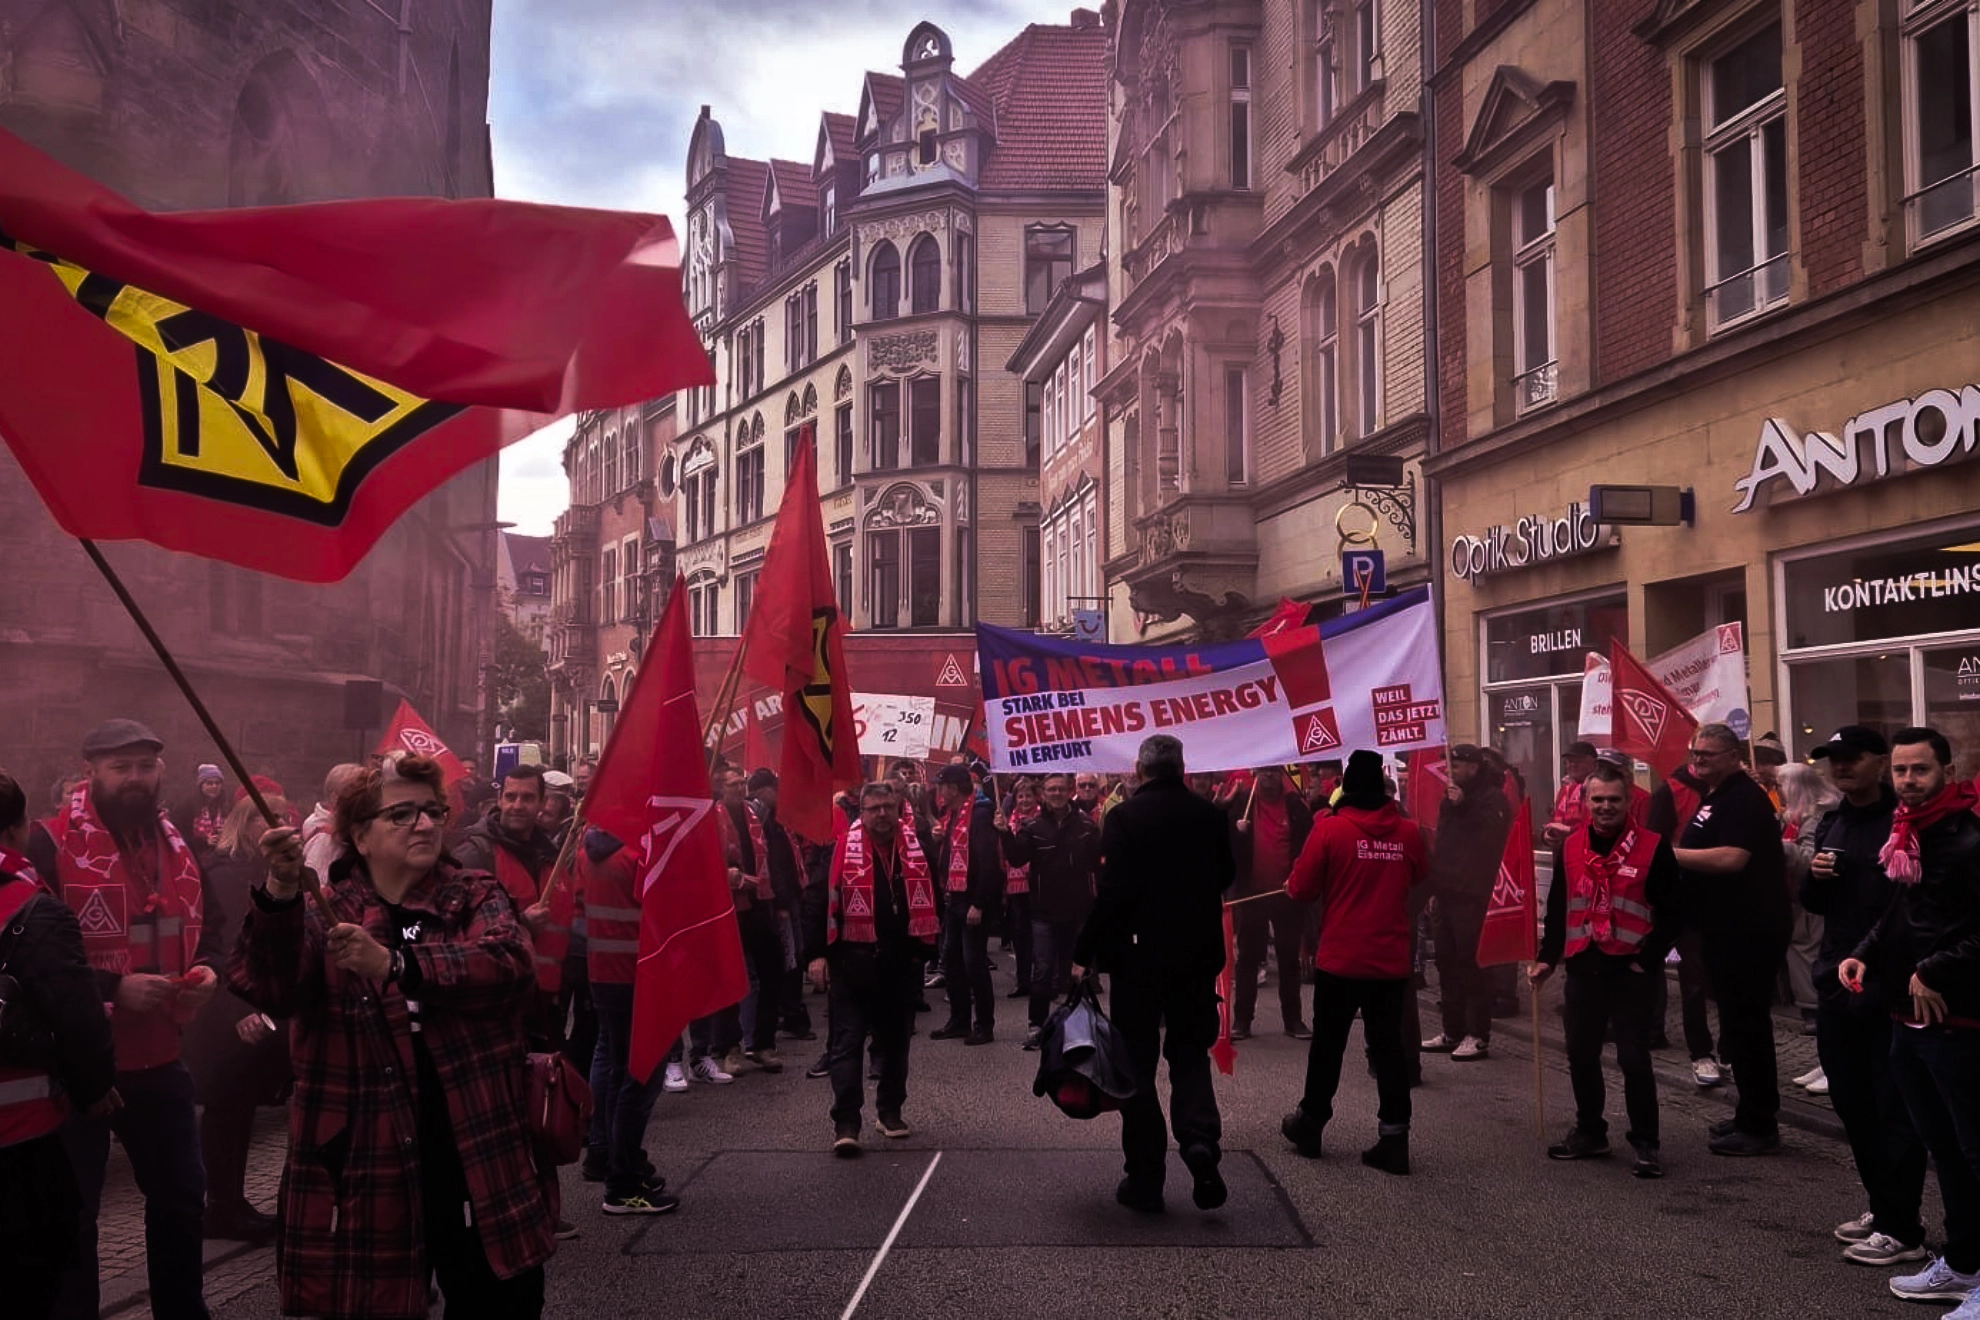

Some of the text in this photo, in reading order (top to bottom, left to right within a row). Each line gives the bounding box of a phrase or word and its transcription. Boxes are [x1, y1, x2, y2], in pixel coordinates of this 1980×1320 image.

[1452, 503, 1597, 586] Optik Studio
[1353, 556, 1375, 587] P
[1531, 629, 1581, 653] BRILLEN
[993, 653, 1213, 697] IG METALL
[1002, 691, 1086, 715] STARK BEI
[1375, 688, 1407, 704] WEIL
[1005, 675, 1278, 748] SIEMENS ENERGY
[1378, 704, 1440, 724] DAS JETZT
[882, 728, 898, 742] 12
[1380, 726, 1423, 743] ZÄHLT.
[1009, 741, 1093, 767] IN ERFURT
[1357, 839, 1403, 851] IG Metall
[1358, 850, 1403, 860] Eisenach
